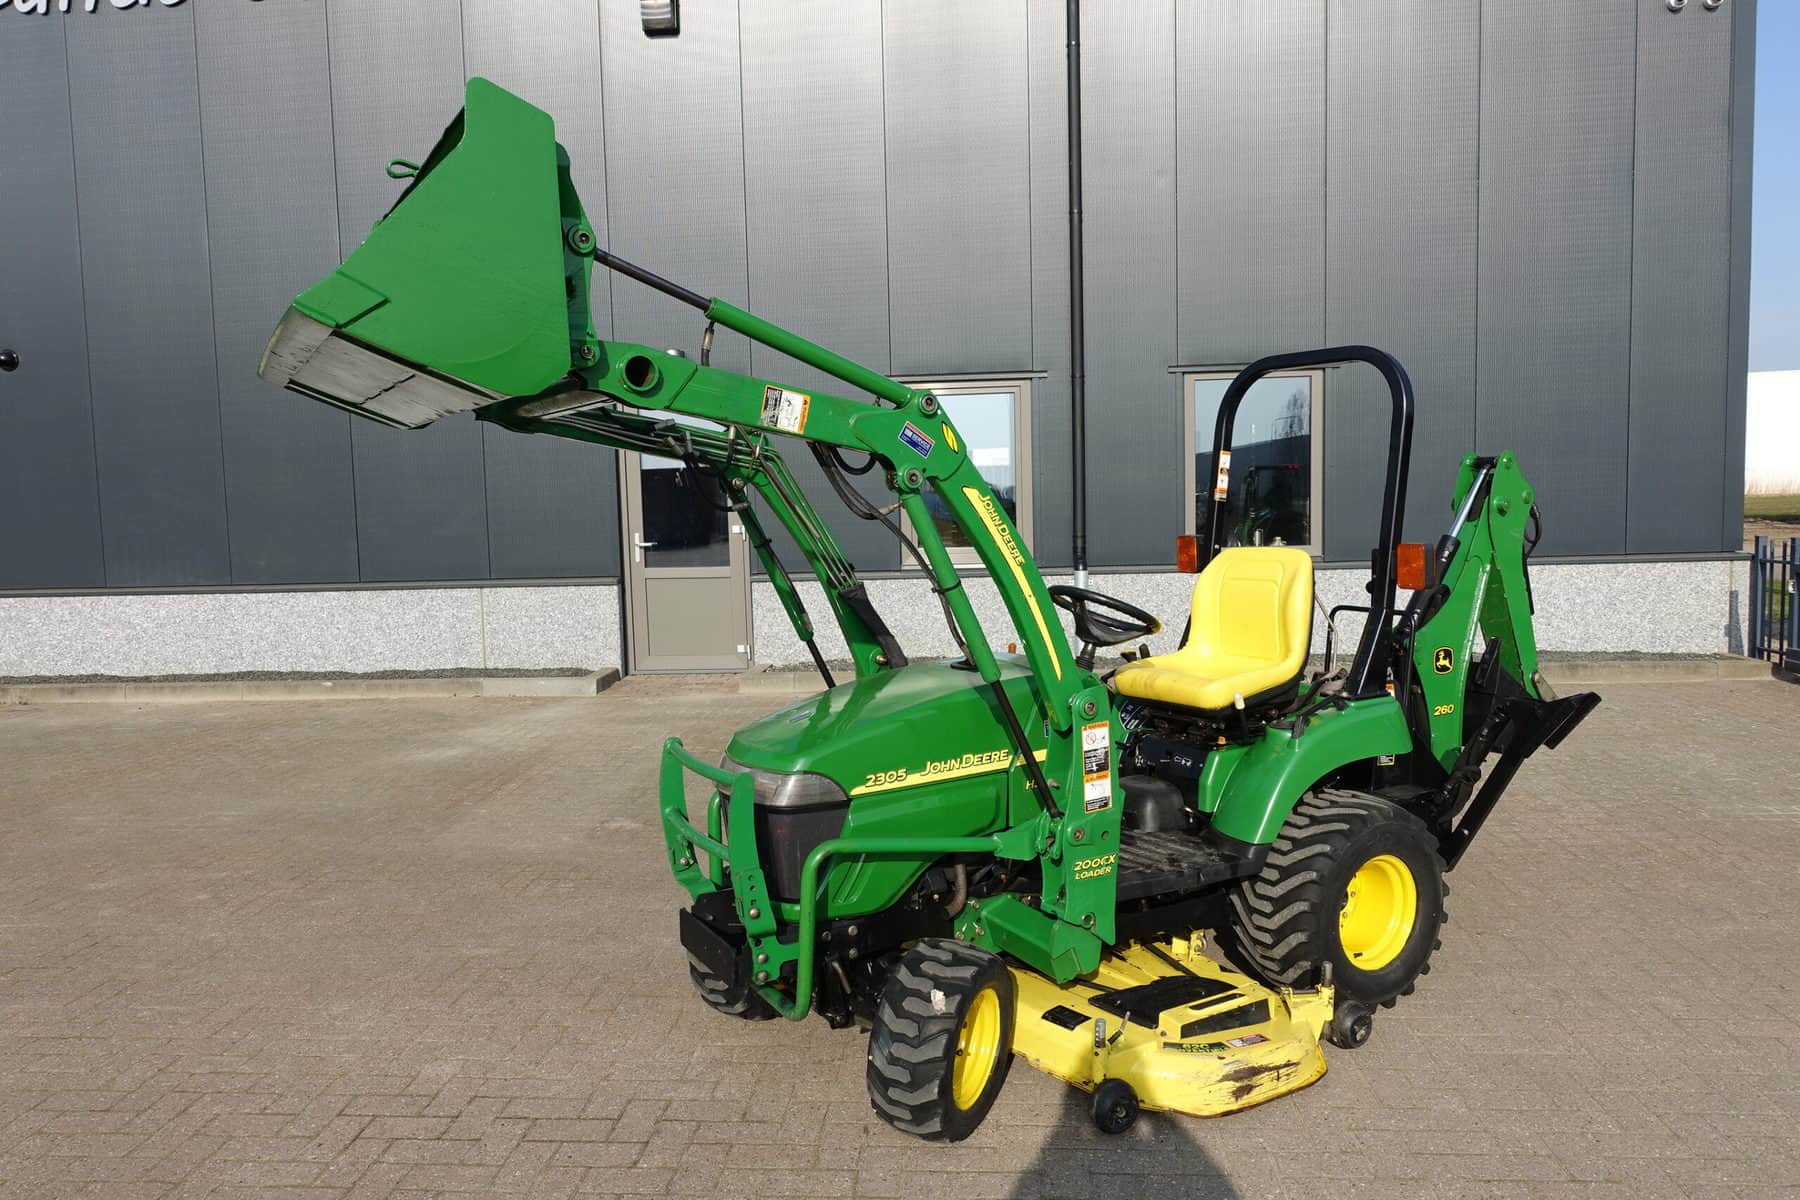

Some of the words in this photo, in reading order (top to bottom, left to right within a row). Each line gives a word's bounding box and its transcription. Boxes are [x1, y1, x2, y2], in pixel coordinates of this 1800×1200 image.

[1433, 703, 1455, 716] 260
[865, 768, 908, 787] 2305
[920, 758, 961, 776] JOHN
[961, 749, 1009, 769] DEERE
[1075, 866, 1112, 880] LOADER
